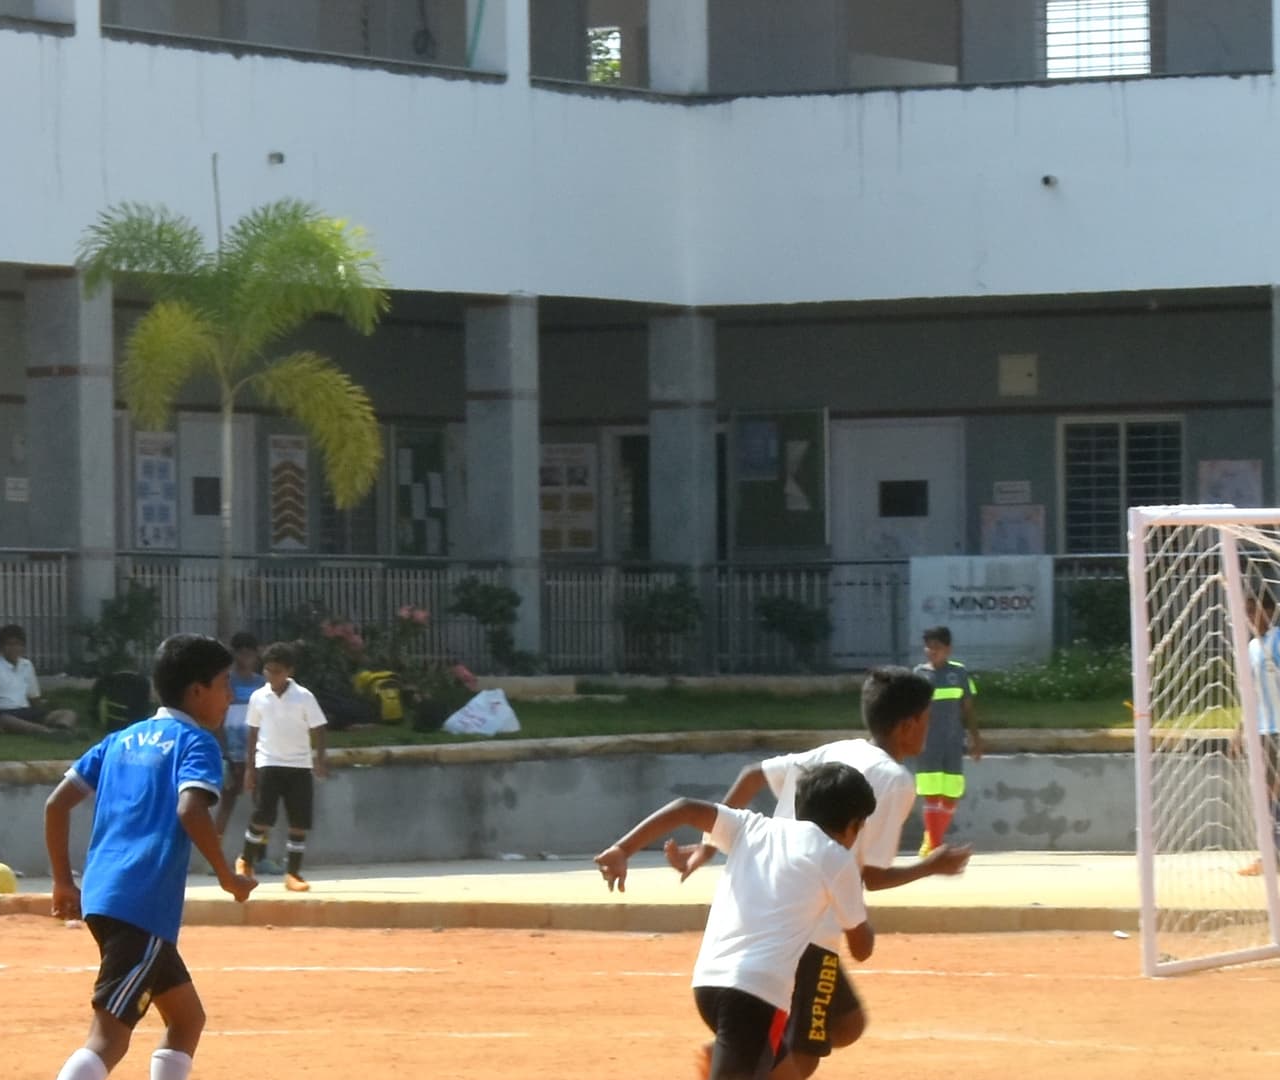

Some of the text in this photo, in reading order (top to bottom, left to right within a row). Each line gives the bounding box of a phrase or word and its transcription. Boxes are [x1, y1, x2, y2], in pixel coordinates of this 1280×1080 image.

[949, 595, 1035, 611] MINDBOX
[121, 730, 175, 756] TVSA
[808, 954, 839, 1041] EXPLORE
